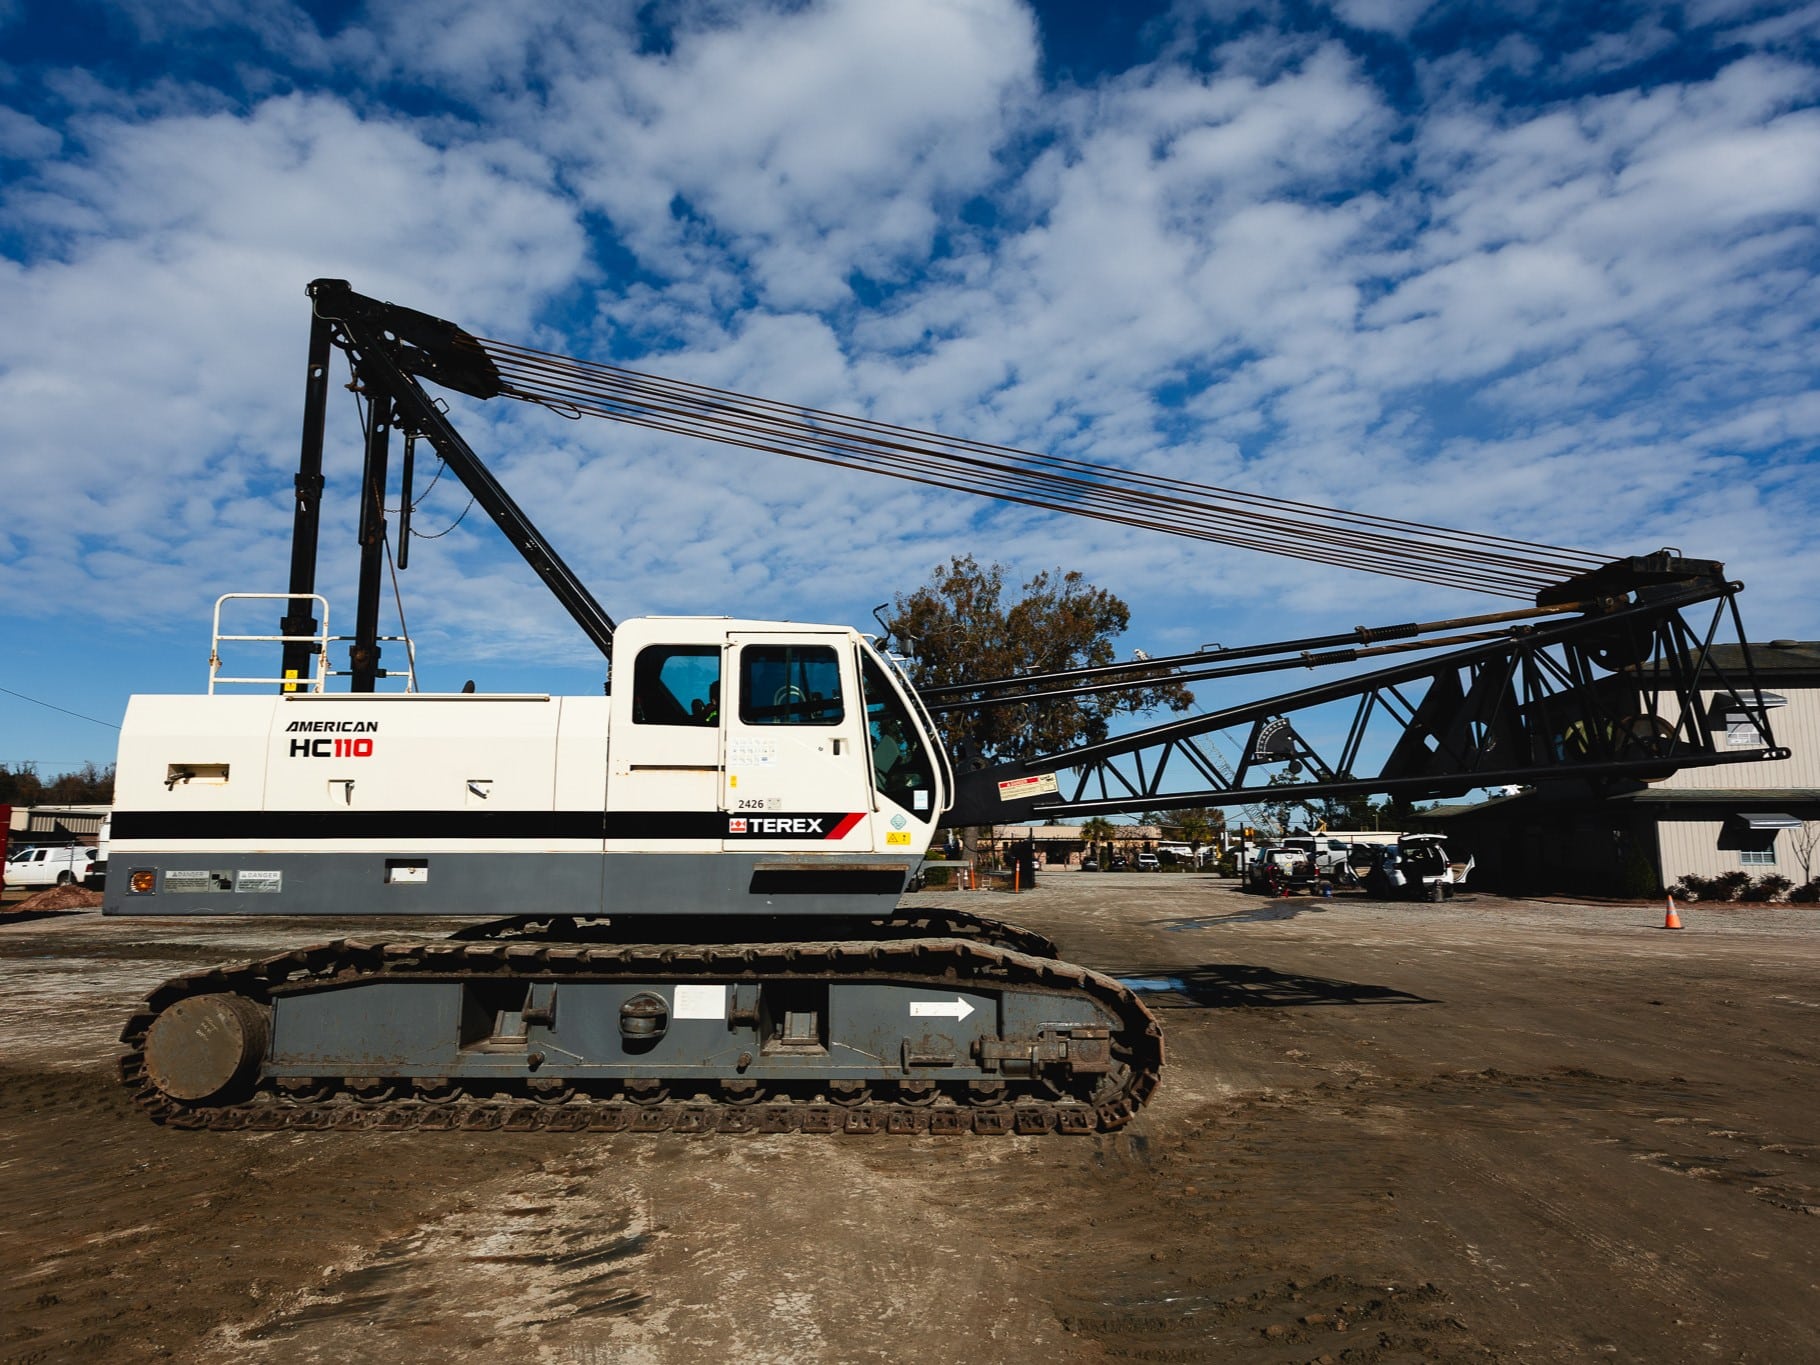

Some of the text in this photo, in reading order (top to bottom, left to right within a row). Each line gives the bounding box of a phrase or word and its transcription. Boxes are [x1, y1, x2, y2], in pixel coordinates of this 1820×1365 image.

[286, 721, 379, 733] AMERICAN
[289, 738, 373, 758] HC110
[738, 800, 764, 809] 2426
[749, 819, 823, 833] TEREX
